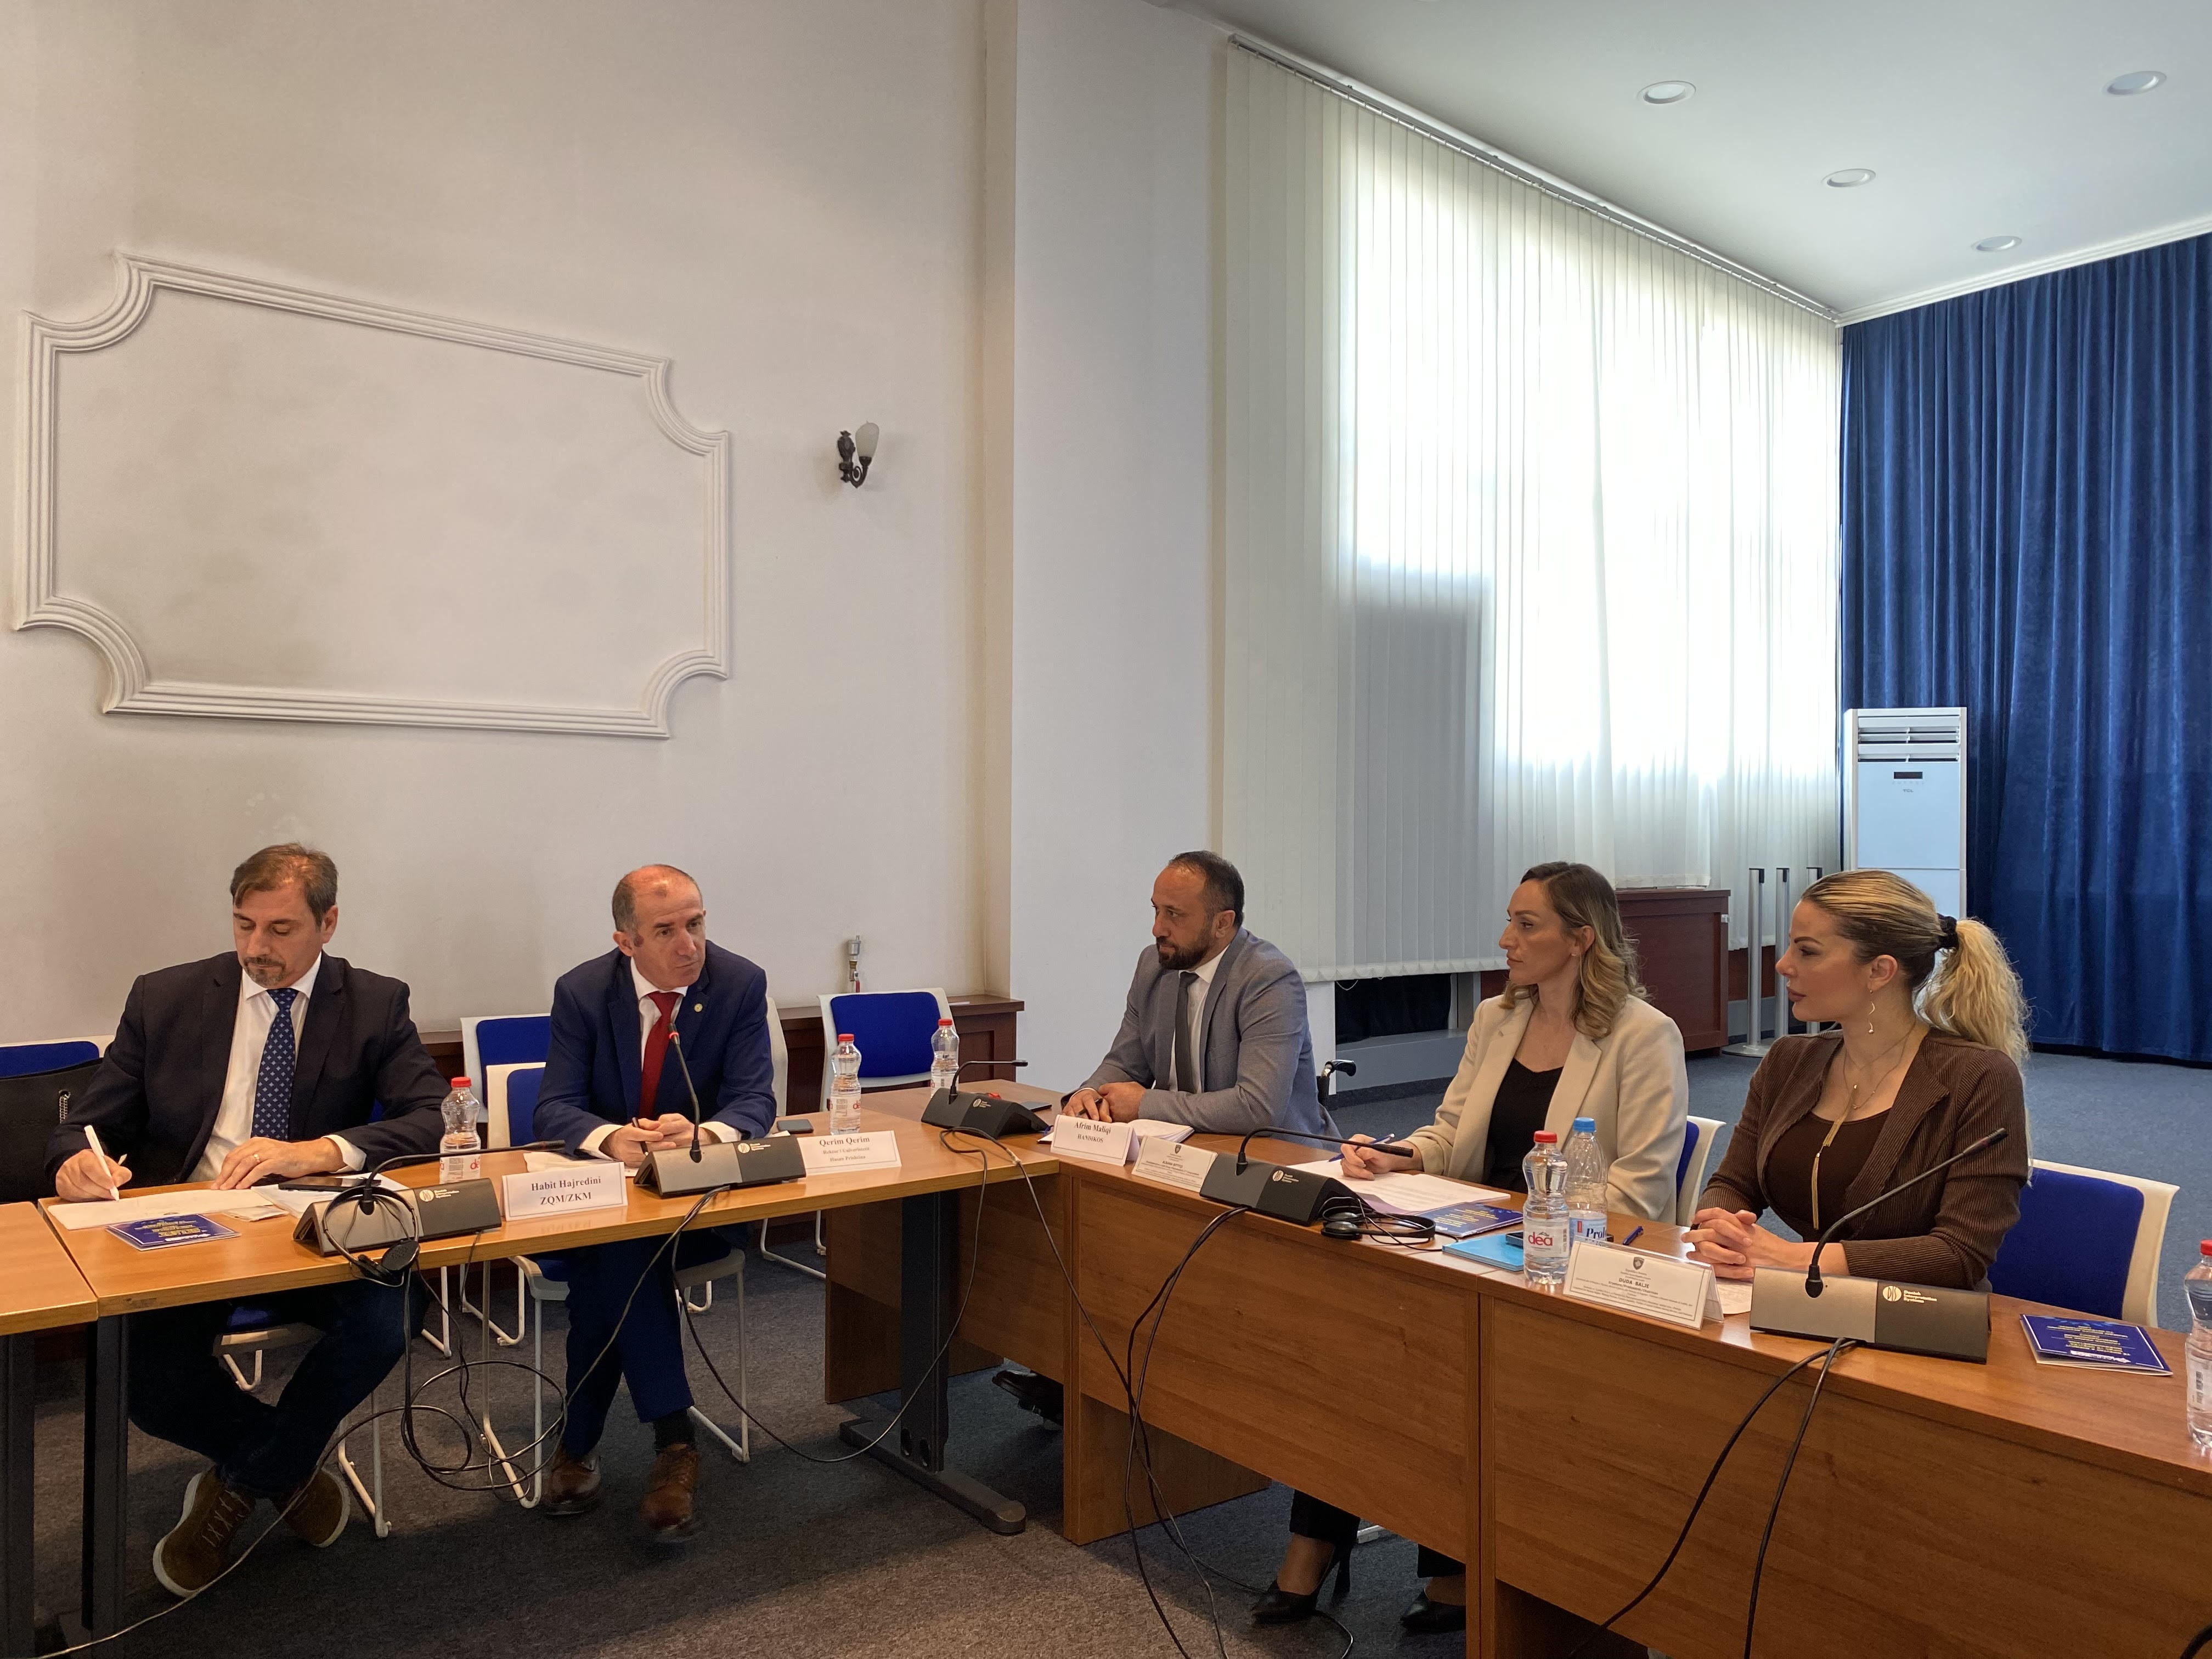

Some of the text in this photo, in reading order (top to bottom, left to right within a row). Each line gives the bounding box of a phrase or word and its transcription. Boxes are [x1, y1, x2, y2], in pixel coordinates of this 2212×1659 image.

[1074, 1121, 1111, 1135] Afrim Maliqi
[819, 1136, 870, 1147] Qerim Qerim
[1077, 1133, 1104, 1143] HANDIKOS
[531, 1176, 601, 1191] Habit Hajredini
[540, 1191, 592, 1205] ZQM/ZKM
[1528, 1232, 1553, 1246] dea
[1586, 1227, 1607, 1239] Prol
